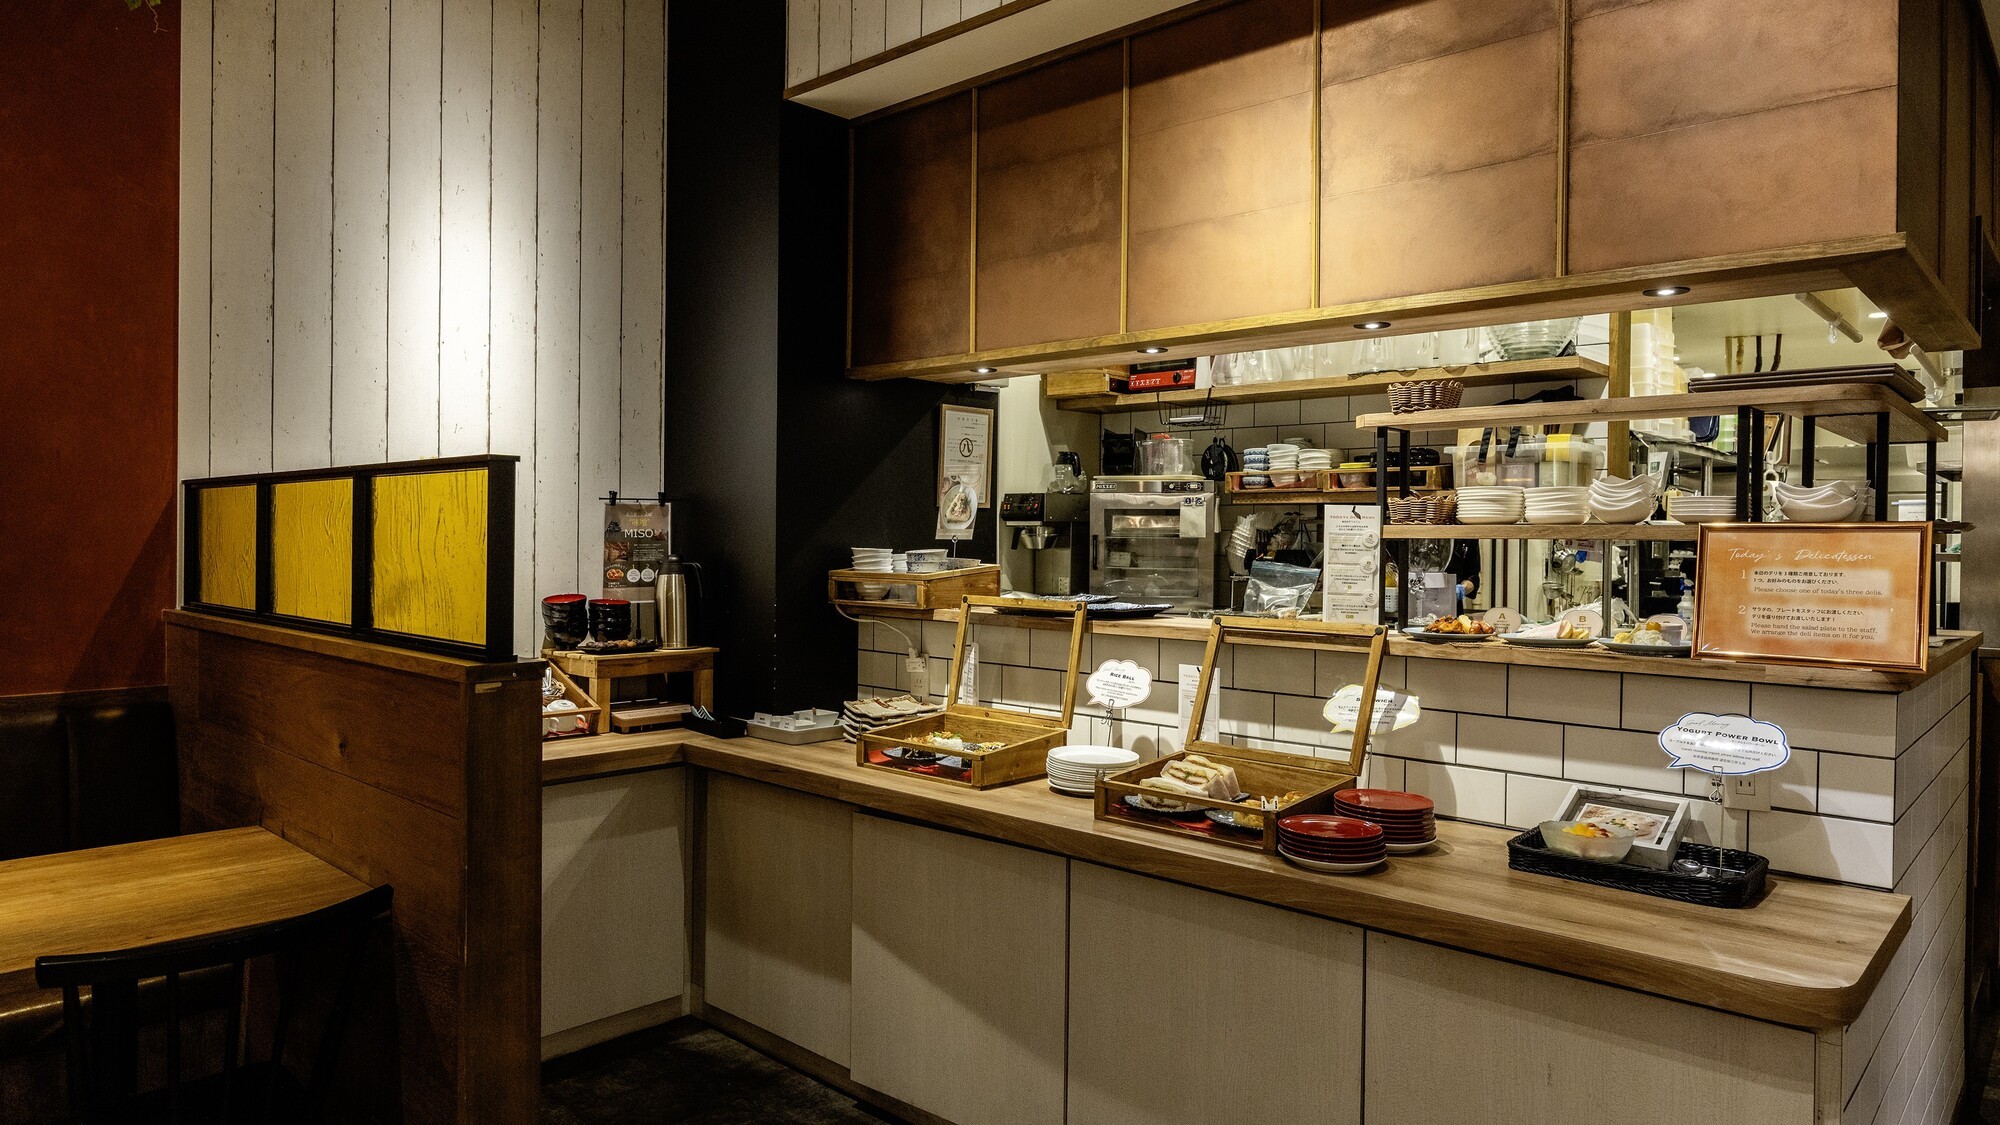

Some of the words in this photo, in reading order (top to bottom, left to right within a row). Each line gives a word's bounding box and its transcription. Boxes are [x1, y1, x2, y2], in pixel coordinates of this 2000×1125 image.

[624, 528, 654, 538] MISO
[1794, 549, 1875, 562] Delicatessen
[1741, 570, 1746, 579] 1
[1738, 605, 1746, 614] 2
[1715, 732, 1748, 740] POWER
[1752, 736, 1779, 745] BOWL
